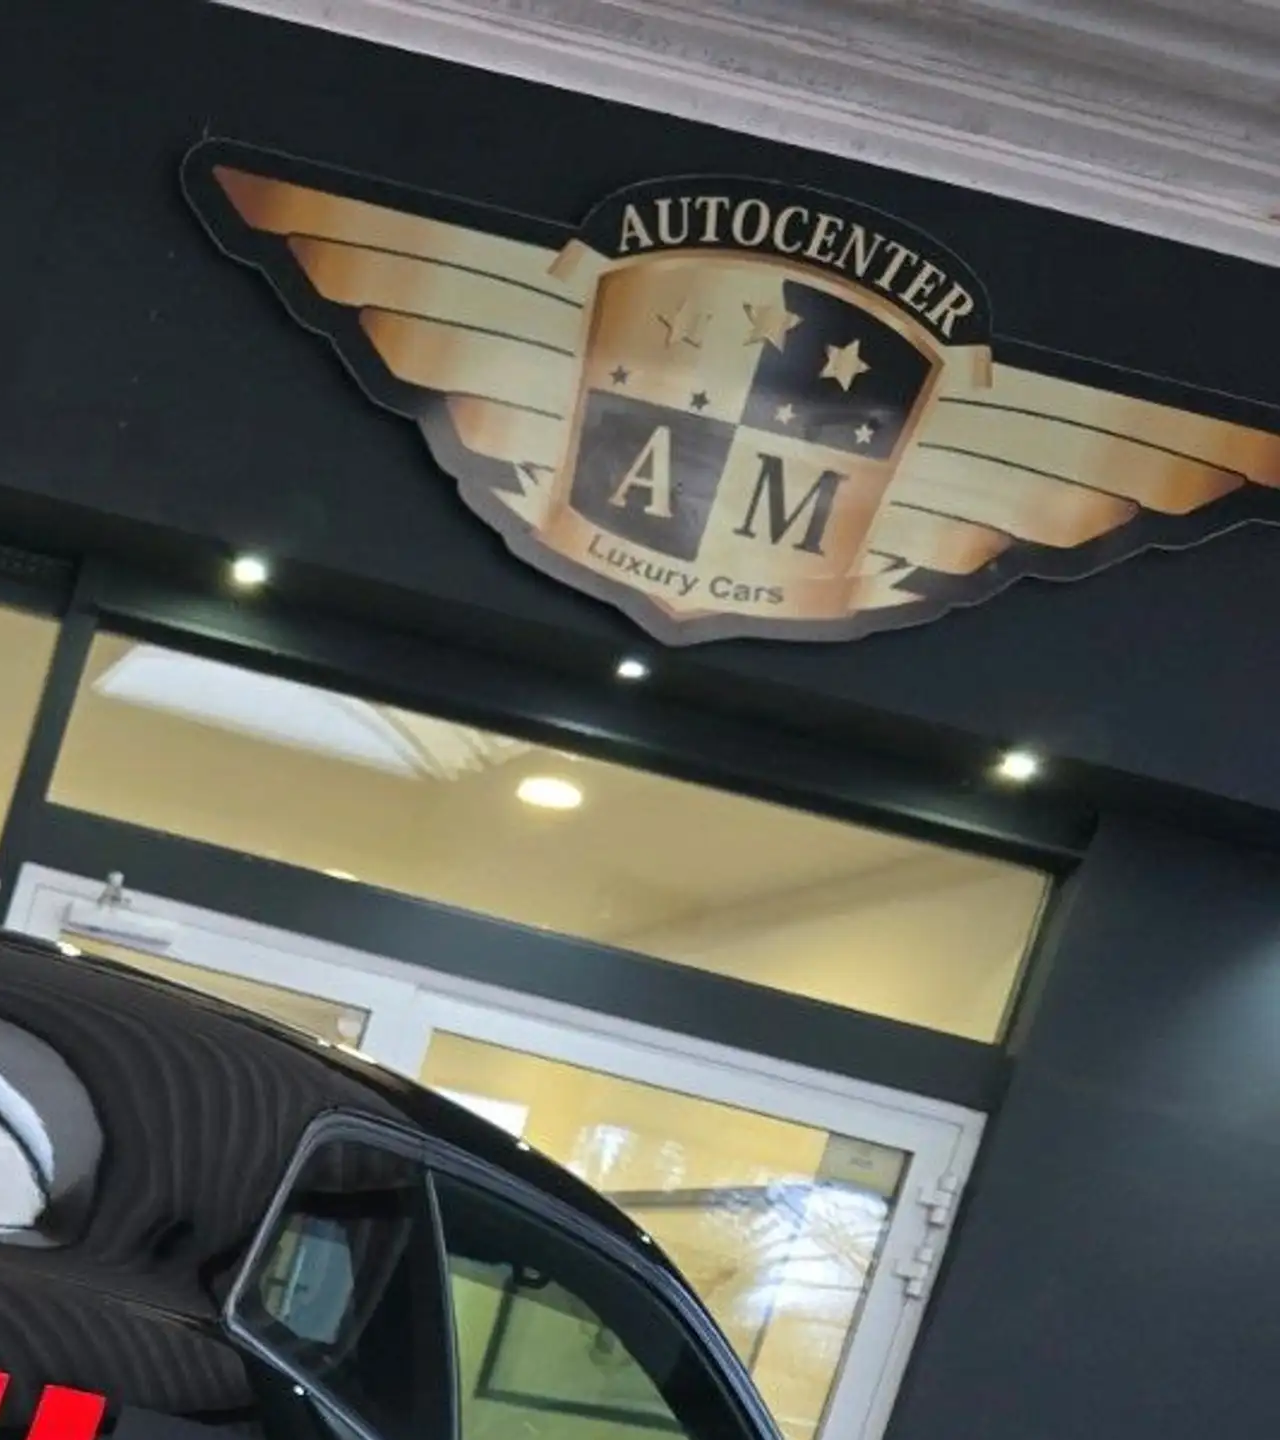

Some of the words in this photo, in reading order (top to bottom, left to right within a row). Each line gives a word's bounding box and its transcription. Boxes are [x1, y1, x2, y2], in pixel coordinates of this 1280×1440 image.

[618, 196, 975, 339] AUTOCENTER
[608, 425, 674, 518] A
[733, 452, 849, 556] M
[588, 533, 700, 596] Luxury
[708, 575, 785, 604] Cars
